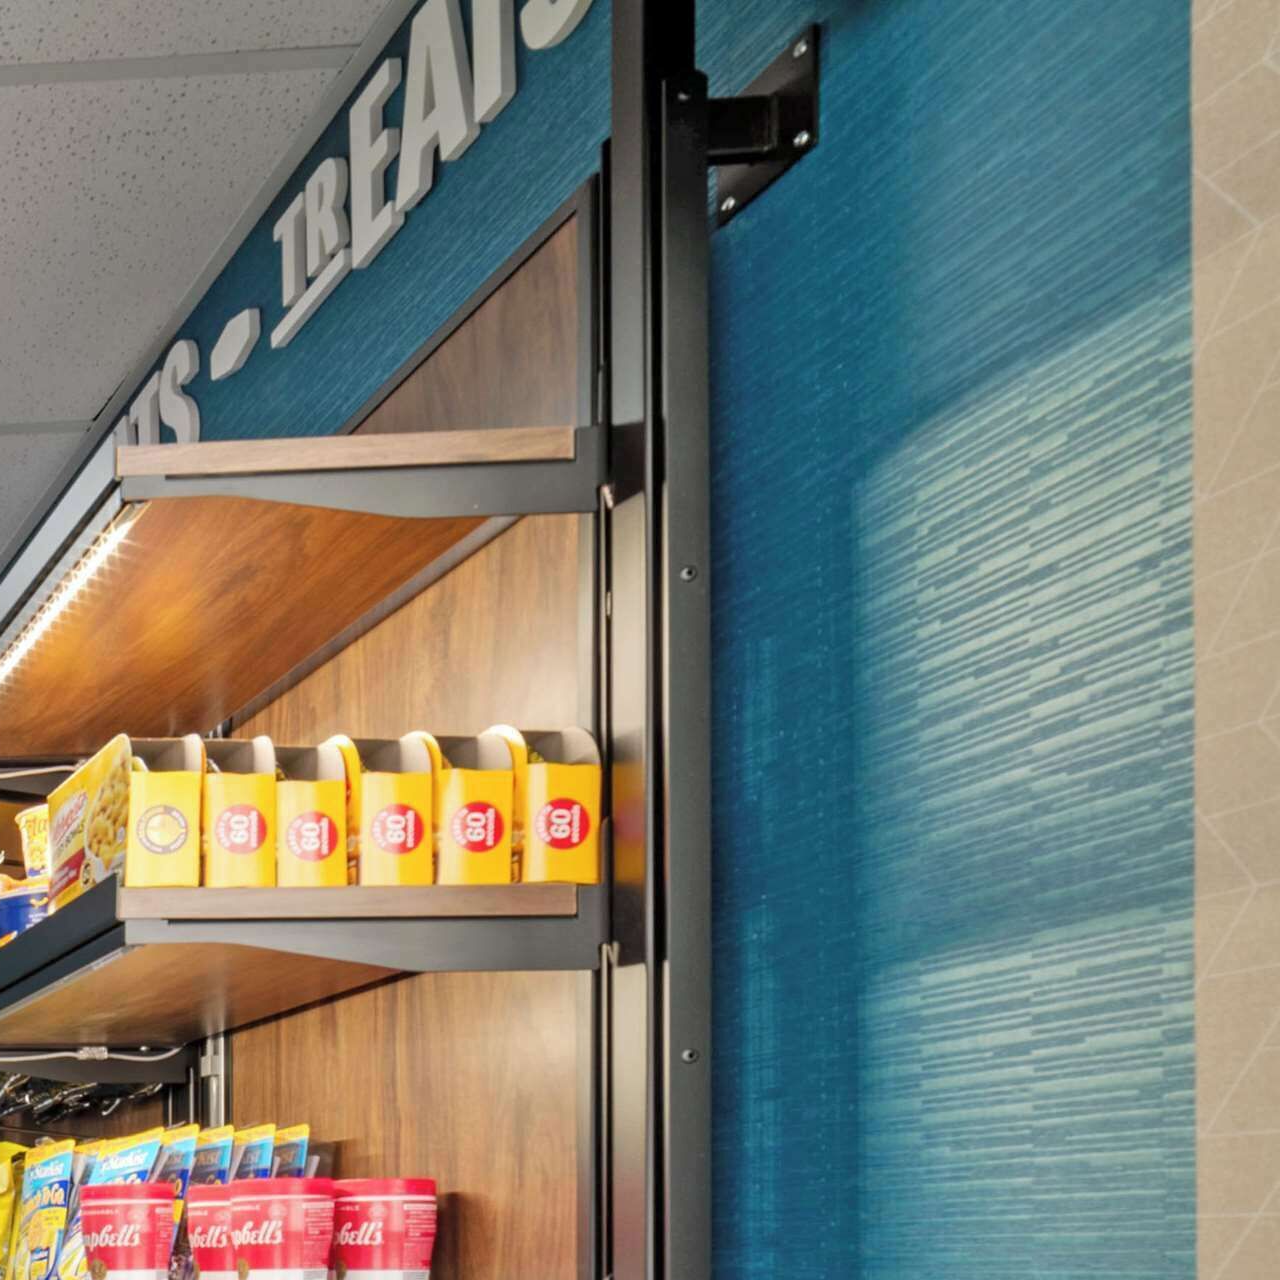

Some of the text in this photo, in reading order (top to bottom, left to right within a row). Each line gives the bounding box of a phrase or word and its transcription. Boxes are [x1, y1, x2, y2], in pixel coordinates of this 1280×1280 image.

[229, 814, 249, 844] 60
[300, 821, 320, 852] 60
[386, 814, 405, 844] 60
[467, 811, 486, 842] 60
[550, 808, 571, 839] 60
